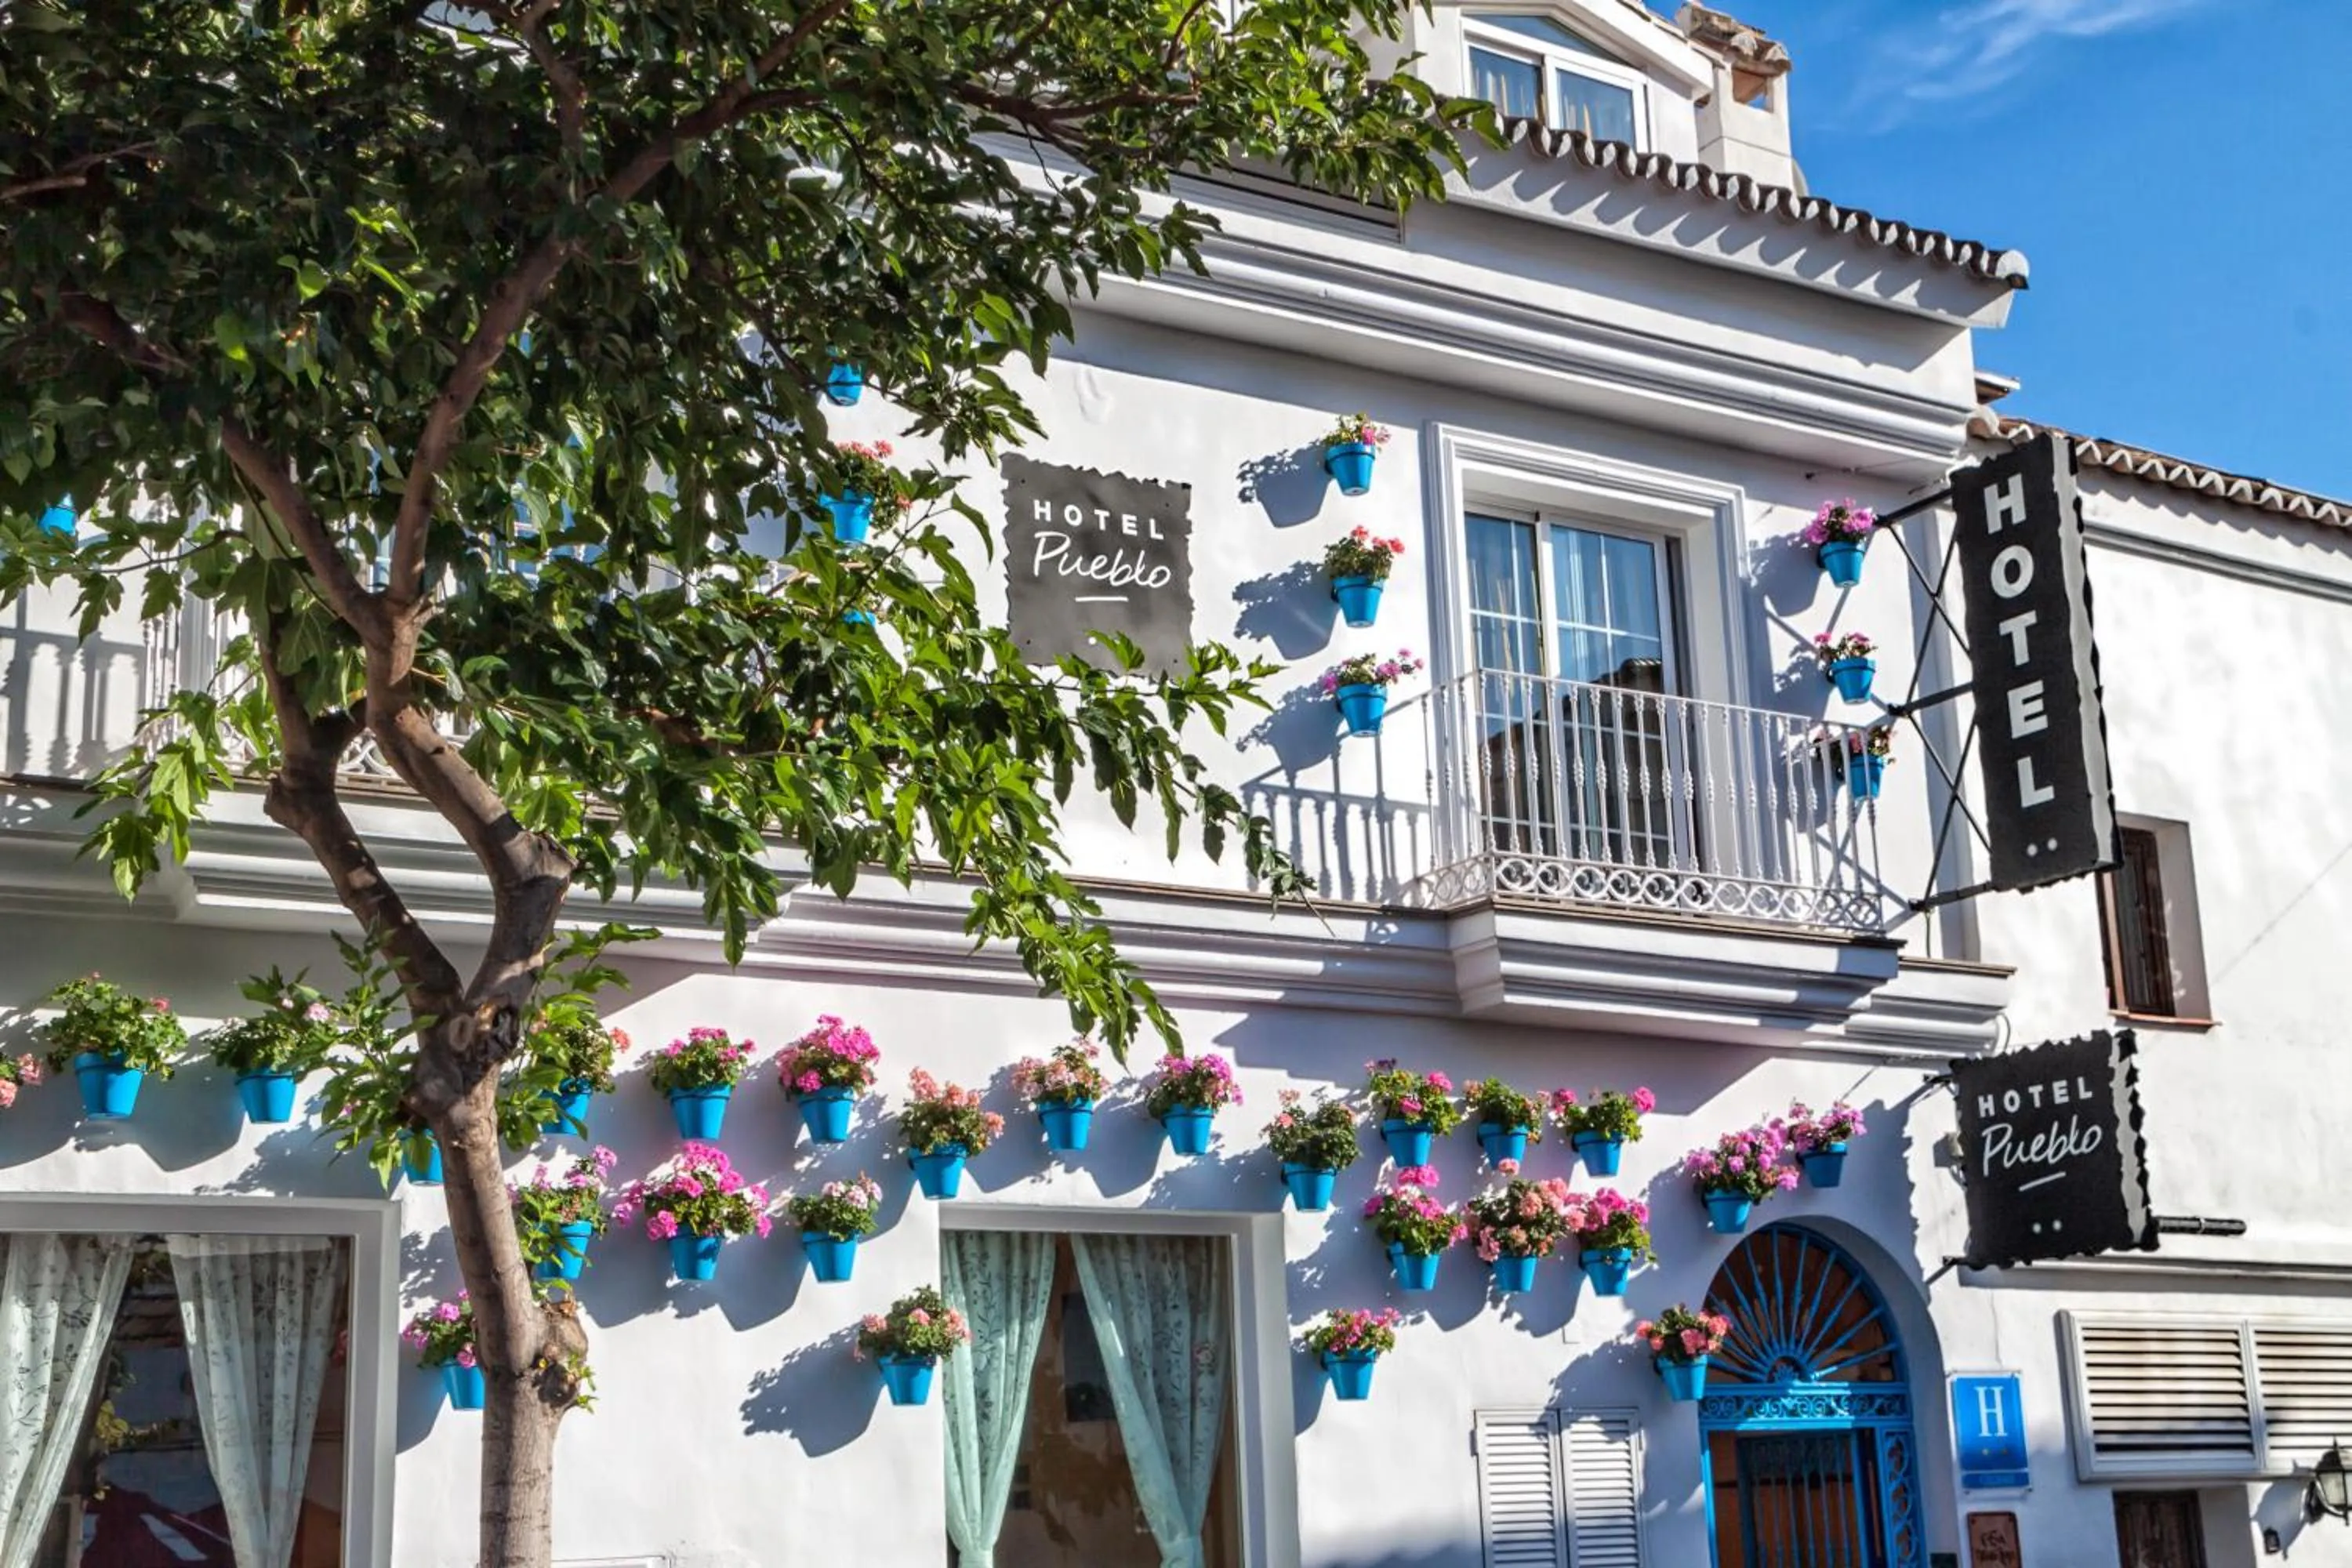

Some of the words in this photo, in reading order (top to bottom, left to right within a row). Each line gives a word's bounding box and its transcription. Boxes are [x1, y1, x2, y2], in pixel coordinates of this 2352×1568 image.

[1033, 499, 1164, 540] HOTEL
[1034, 531, 1172, 588] Pueblo
[1984, 473, 2055, 809] HOTEL
[1978, 1077, 2092, 1118] HOTEL
[1982, 1114, 2102, 1176] Pueblo
[1974, 1386, 2007, 1437] H
